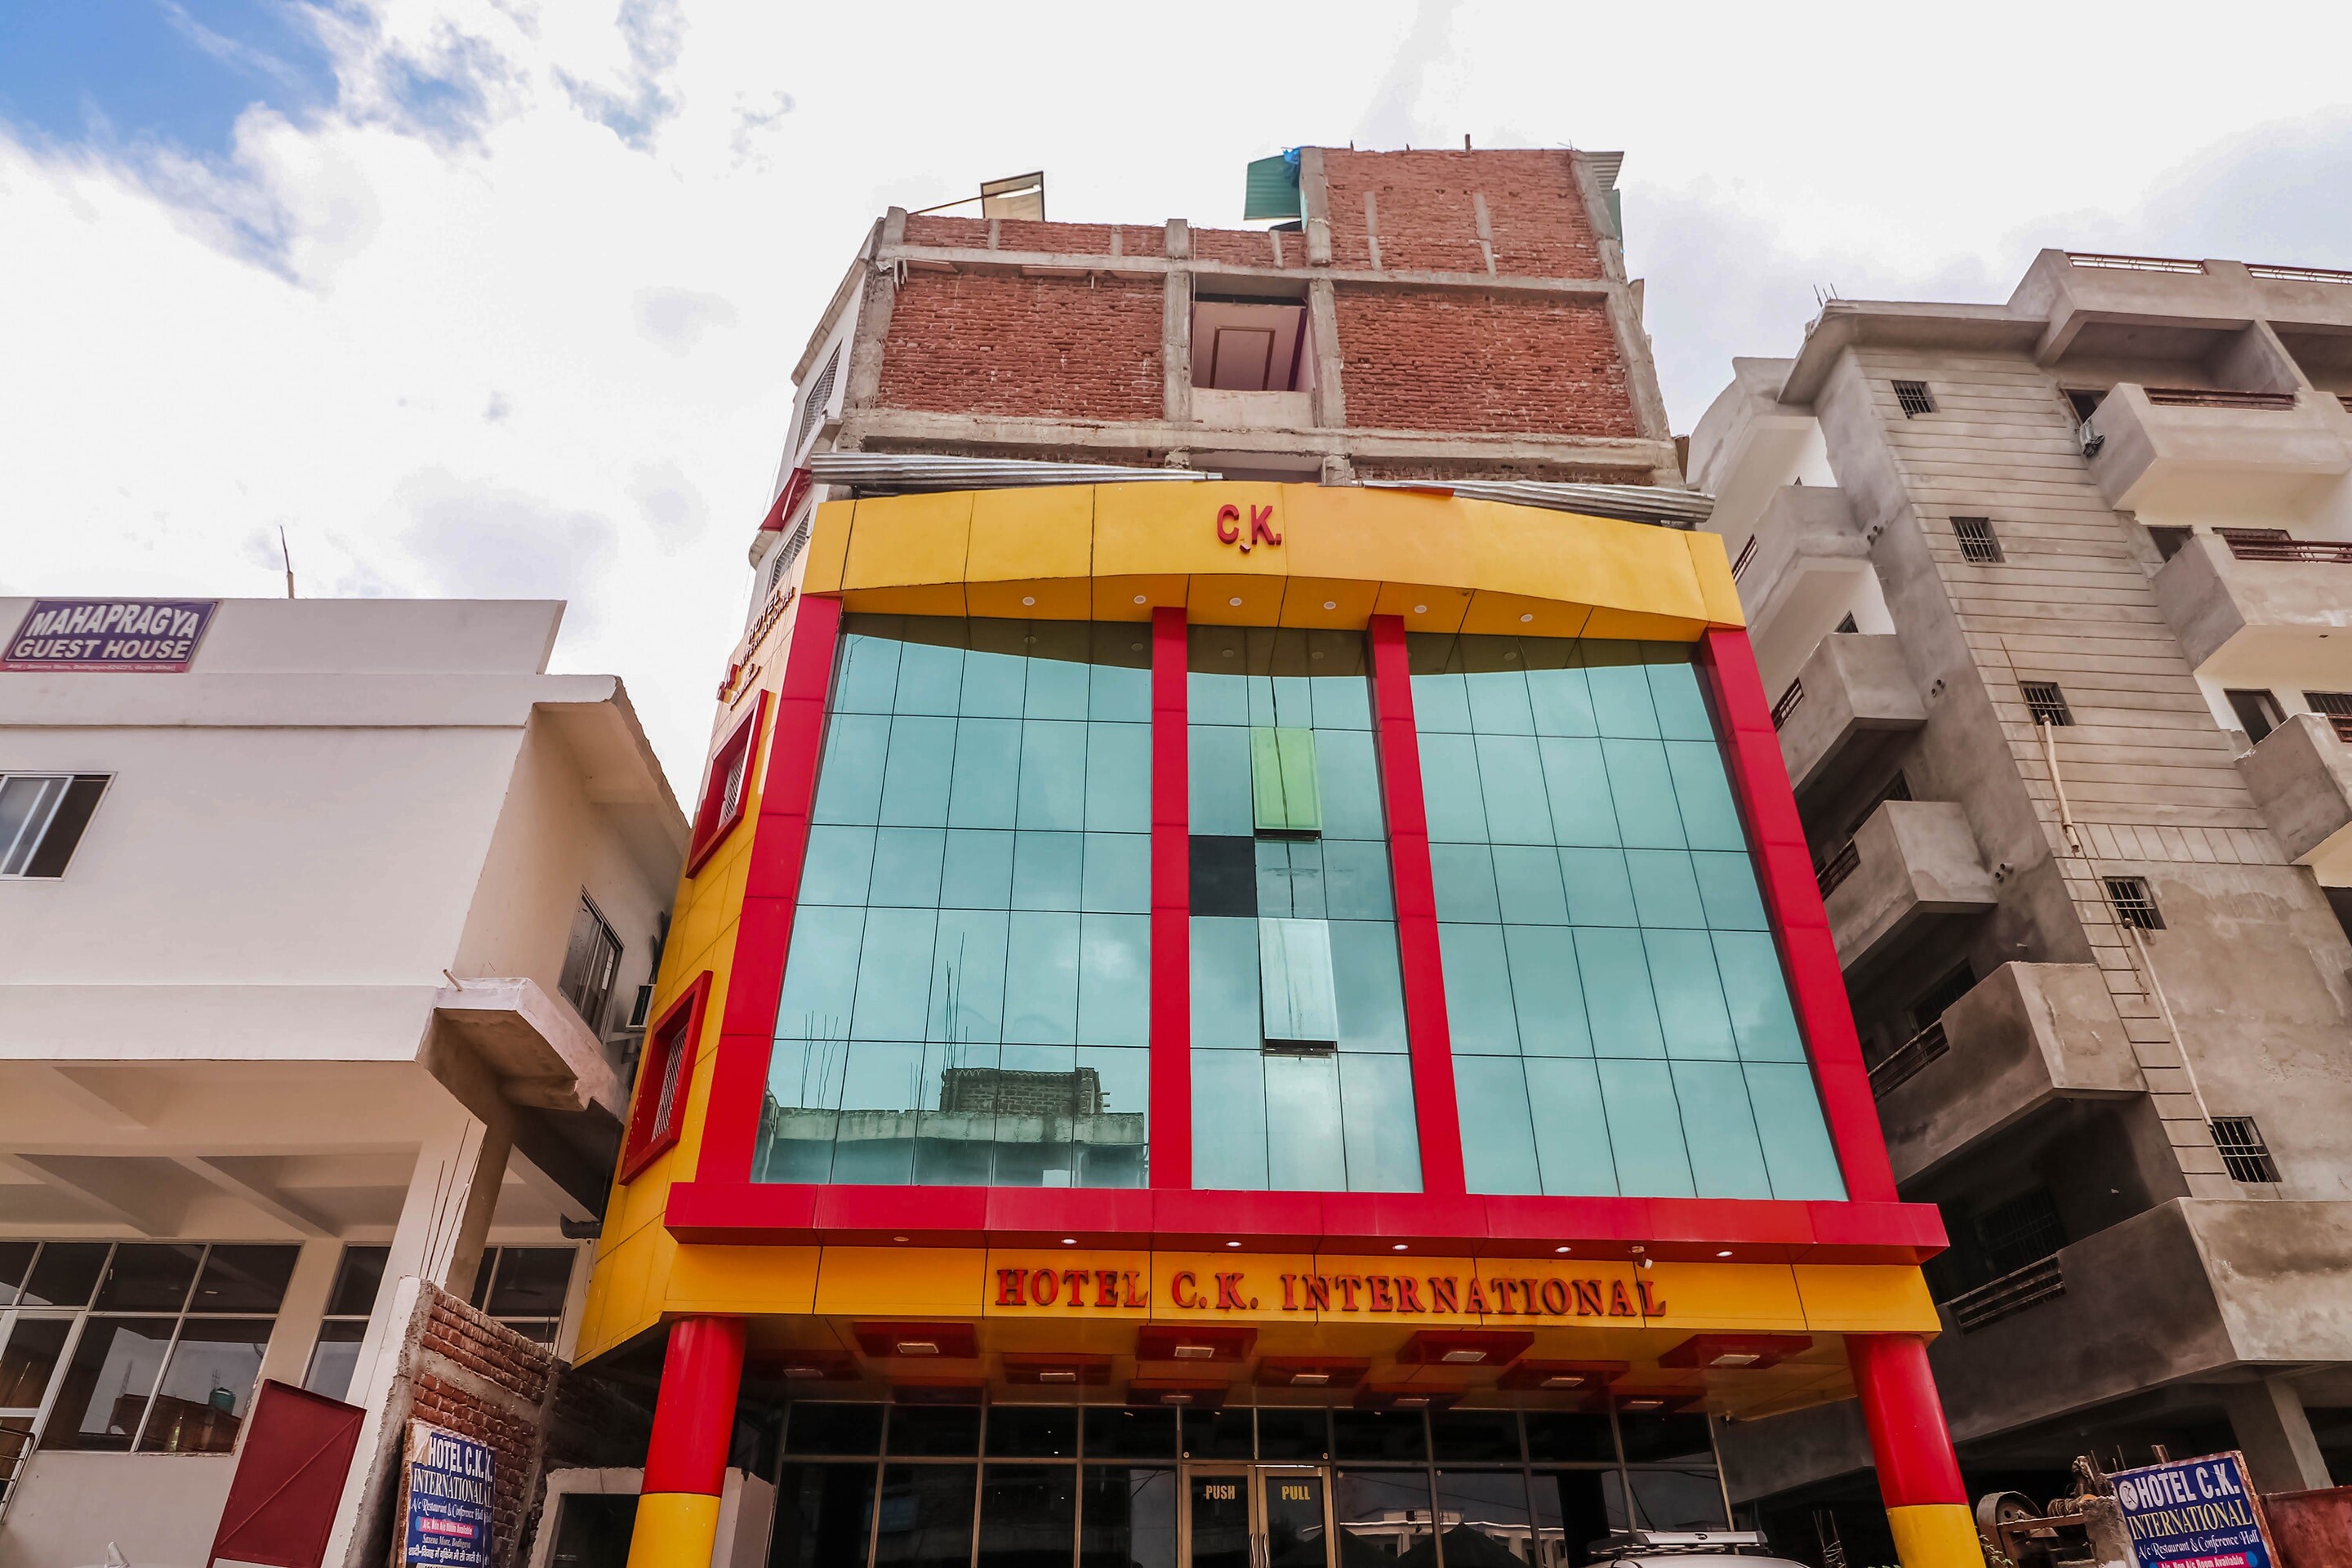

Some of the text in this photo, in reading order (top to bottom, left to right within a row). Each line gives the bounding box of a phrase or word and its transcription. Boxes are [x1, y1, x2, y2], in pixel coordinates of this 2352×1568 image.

[1217, 504, 1281, 554] C.K.
[25, 604, 199, 639] MAHAPRAGYA
[14, 639, 192, 659] GUEST HOUSE
[995, 1268, 1666, 1317] HOTEL C.K. INTERNATIONAL
[428, 1437, 483, 1479] HOTEL C.K.
[412, 1468, 483, 1505] INTERNATIONAL
[1205, 1486, 1235, 1499] PUSH
[1281, 1486, 1310, 1500] PULL
[2134, 1463, 2241, 1508] HOTEL C.K.
[2127, 1499, 2253, 1540] INTERNATIONAL
[2151, 1542, 2190, 1559] Restaurant
[2190, 1538, 2198, 1552] &
[2198, 1535, 2239, 1553] Conference
[2239, 1530, 2260, 1545] Hall
[2214, 1555, 2243, 1567] Available
